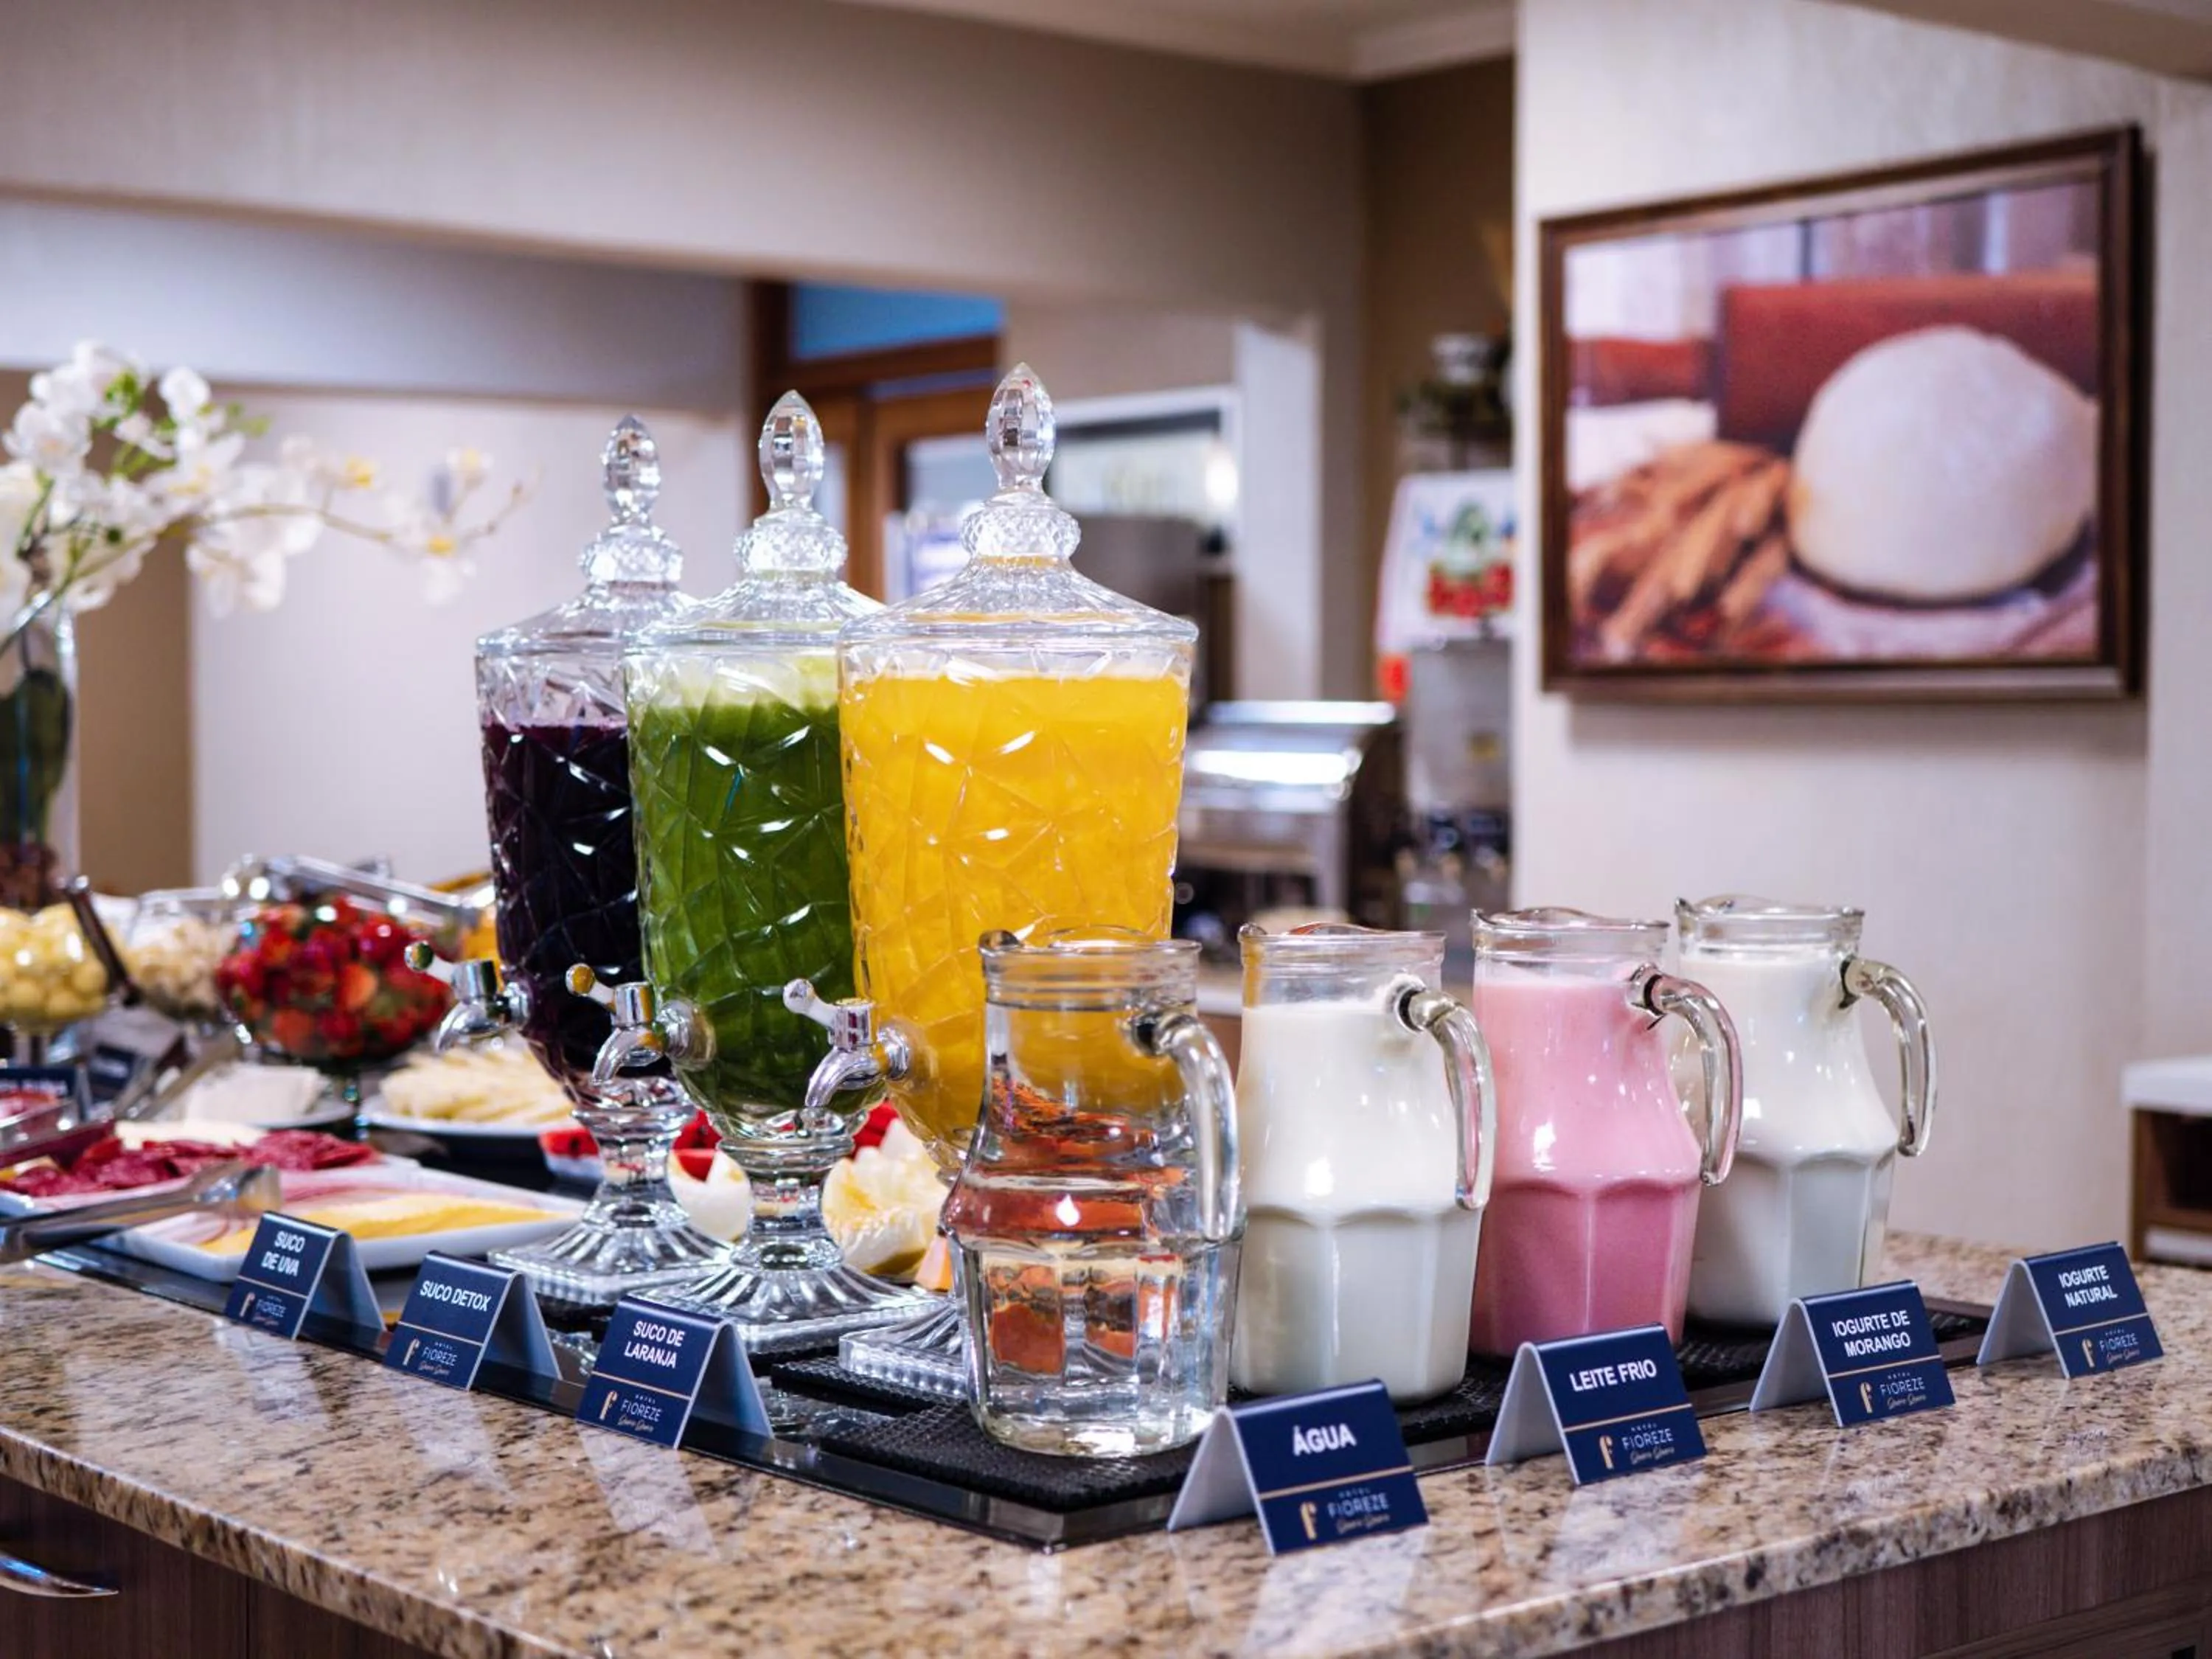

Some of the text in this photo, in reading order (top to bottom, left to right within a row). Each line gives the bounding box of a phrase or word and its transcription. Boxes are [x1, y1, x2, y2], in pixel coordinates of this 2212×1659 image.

[274, 1231, 305, 1253] SUCO
[262, 1251, 299, 1276] DE UVA
[2059, 1265, 2110, 1288] IOGURTE
[420, 1280, 492, 1312] SUCO DETOX
[2065, 1284, 2118, 1308] NATURAL
[633, 1321, 686, 1347] SUCO DE
[1832, 1310, 1910, 1338] IOGURTE DE
[624, 1341, 678, 1368] LARANJA
[1844, 1332, 1911, 1357] MORANGO
[1569, 1359, 1658, 1392] LEITE FRIO
[1879, 1377, 1925, 1396] FIOREZE
[620, 1399, 662, 1422] FIOREZE
[1293, 1423, 1357, 1456] ÁGUA
[1621, 1428, 1674, 1451] FIOREZE
[1327, 1494, 1389, 1518] FIOREZE
